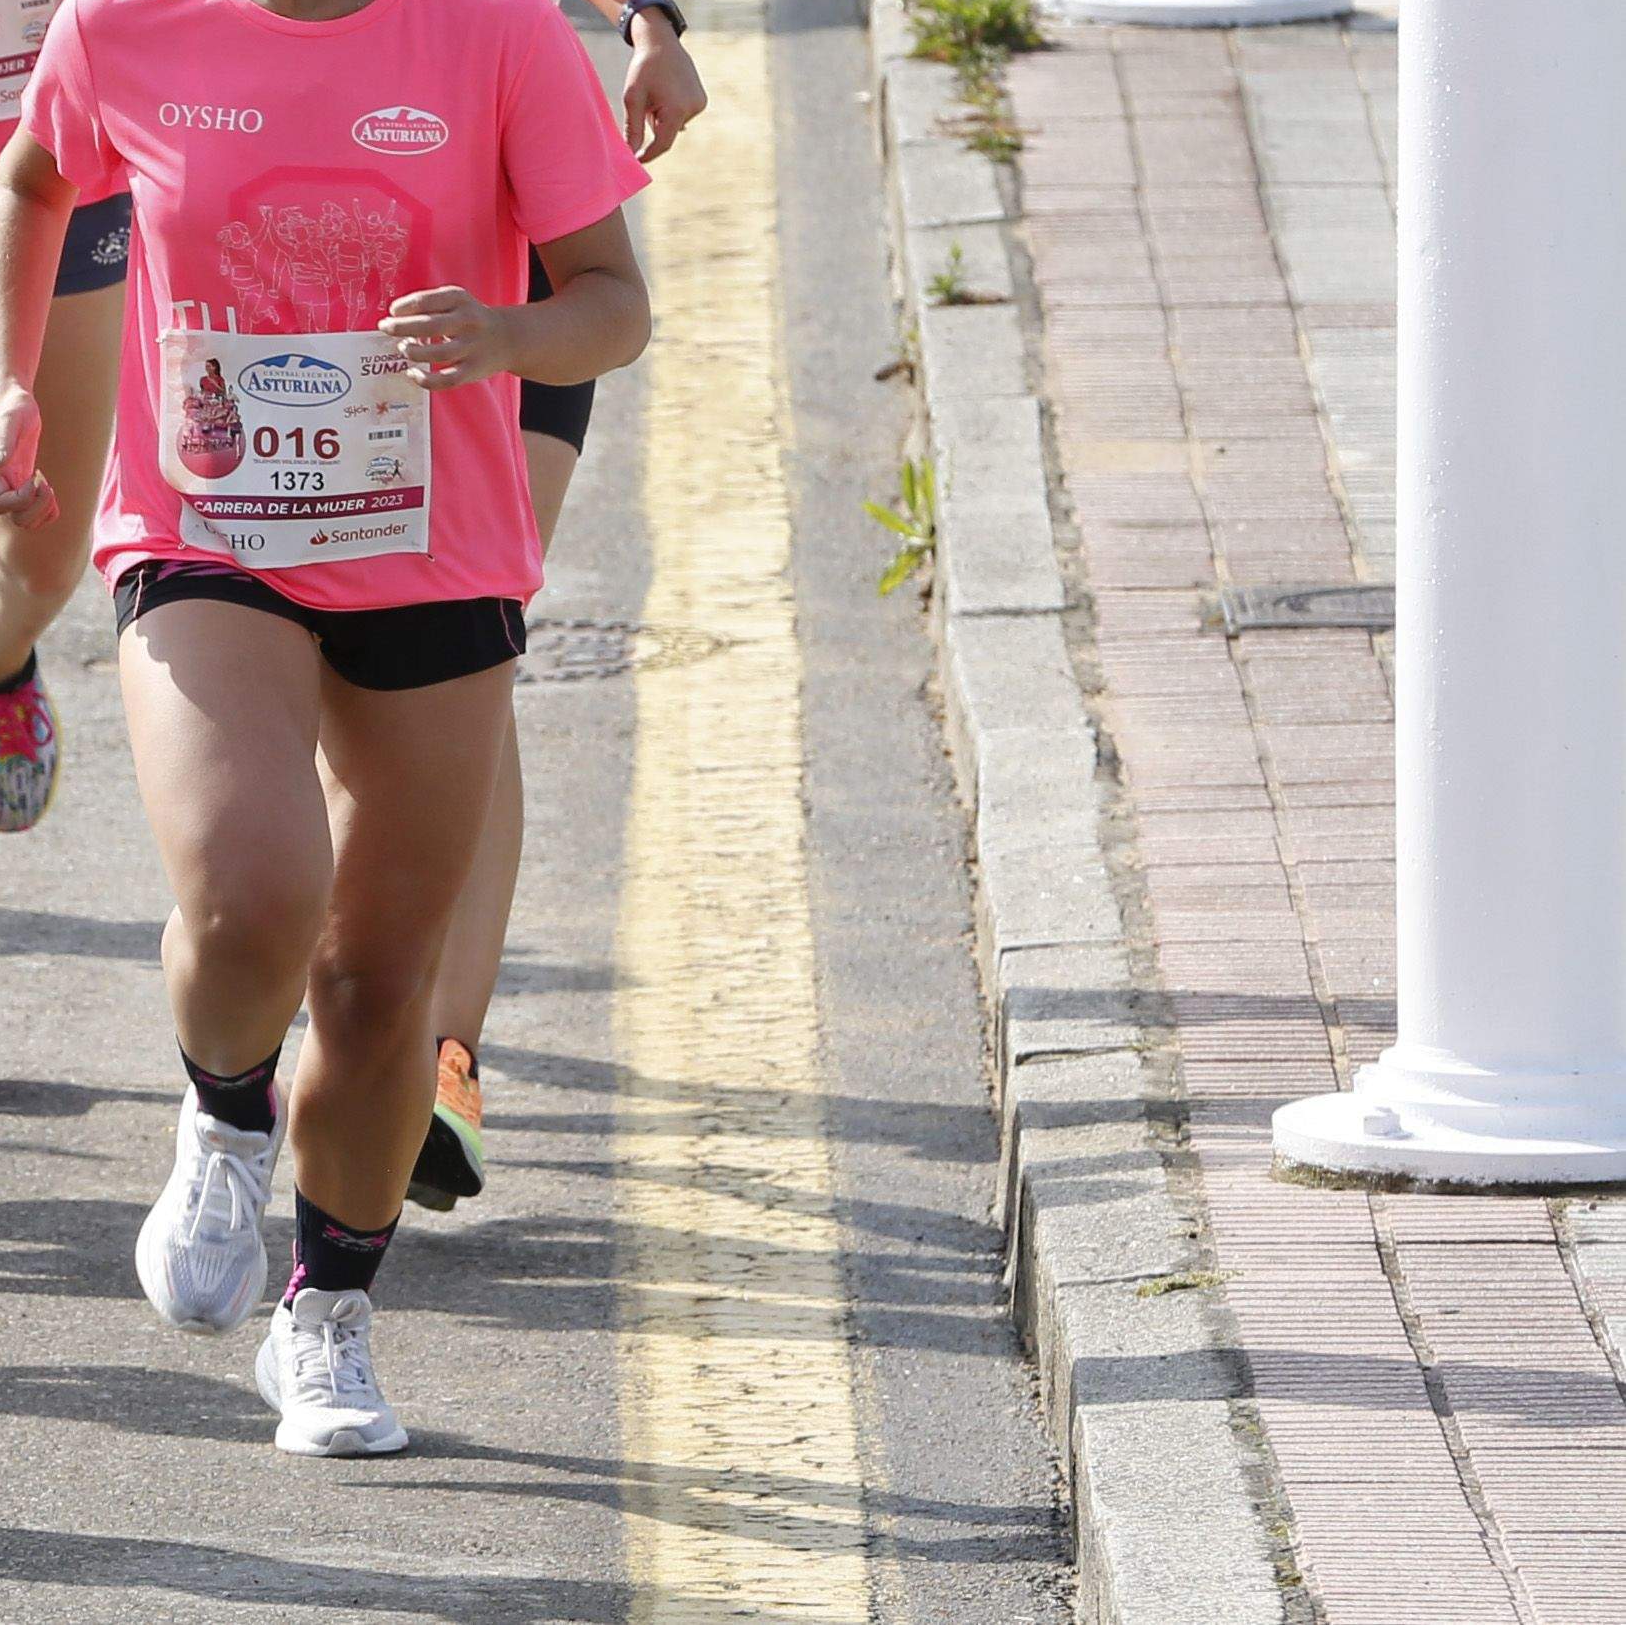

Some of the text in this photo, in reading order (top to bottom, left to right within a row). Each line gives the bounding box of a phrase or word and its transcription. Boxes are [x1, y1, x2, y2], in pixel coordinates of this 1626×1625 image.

[159, 102, 263, 133] OYSHO
[360, 122, 441, 142] ASTURIANA
[361, 362, 409, 376] SUMA
[247, 372, 343, 394] ASTURIANA
[253, 426, 340, 459] 016
[271, 471, 325, 491] 1373
[194, 494, 404, 514] CARRERA DE LA MUJER 2023
[331, 523, 409, 544] Santander
